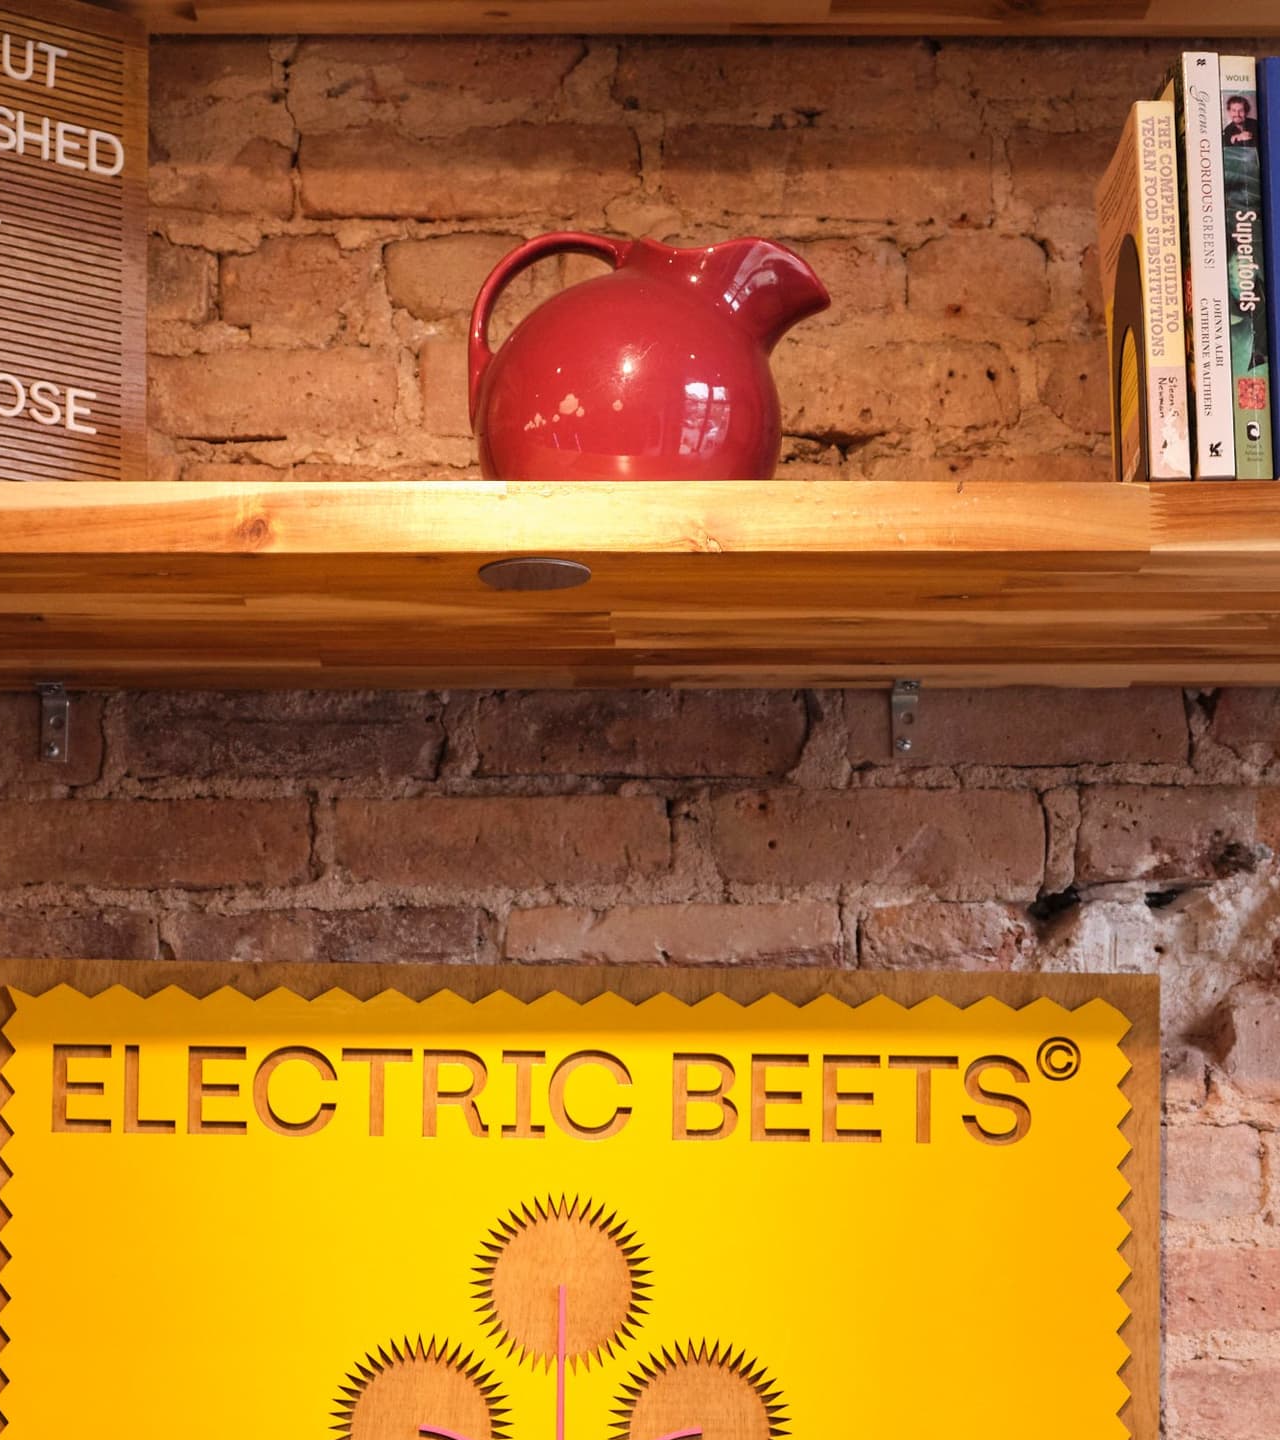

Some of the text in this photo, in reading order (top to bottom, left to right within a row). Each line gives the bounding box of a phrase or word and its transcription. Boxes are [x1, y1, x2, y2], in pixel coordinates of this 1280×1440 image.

[1159, 154, 1176, 248] COMPLETE
[1199, 138, 1213, 213] GLORIOUS
[1141, 116, 1165, 357] VEGAN FOOD SUBSTITUTIONS
[1163, 253, 1179, 306] GUIDE
[1231, 210, 1261, 312] Superfoods
[1166, 310, 1180, 334] TO
[50, 1042, 633, 1142] ELECTRIC
